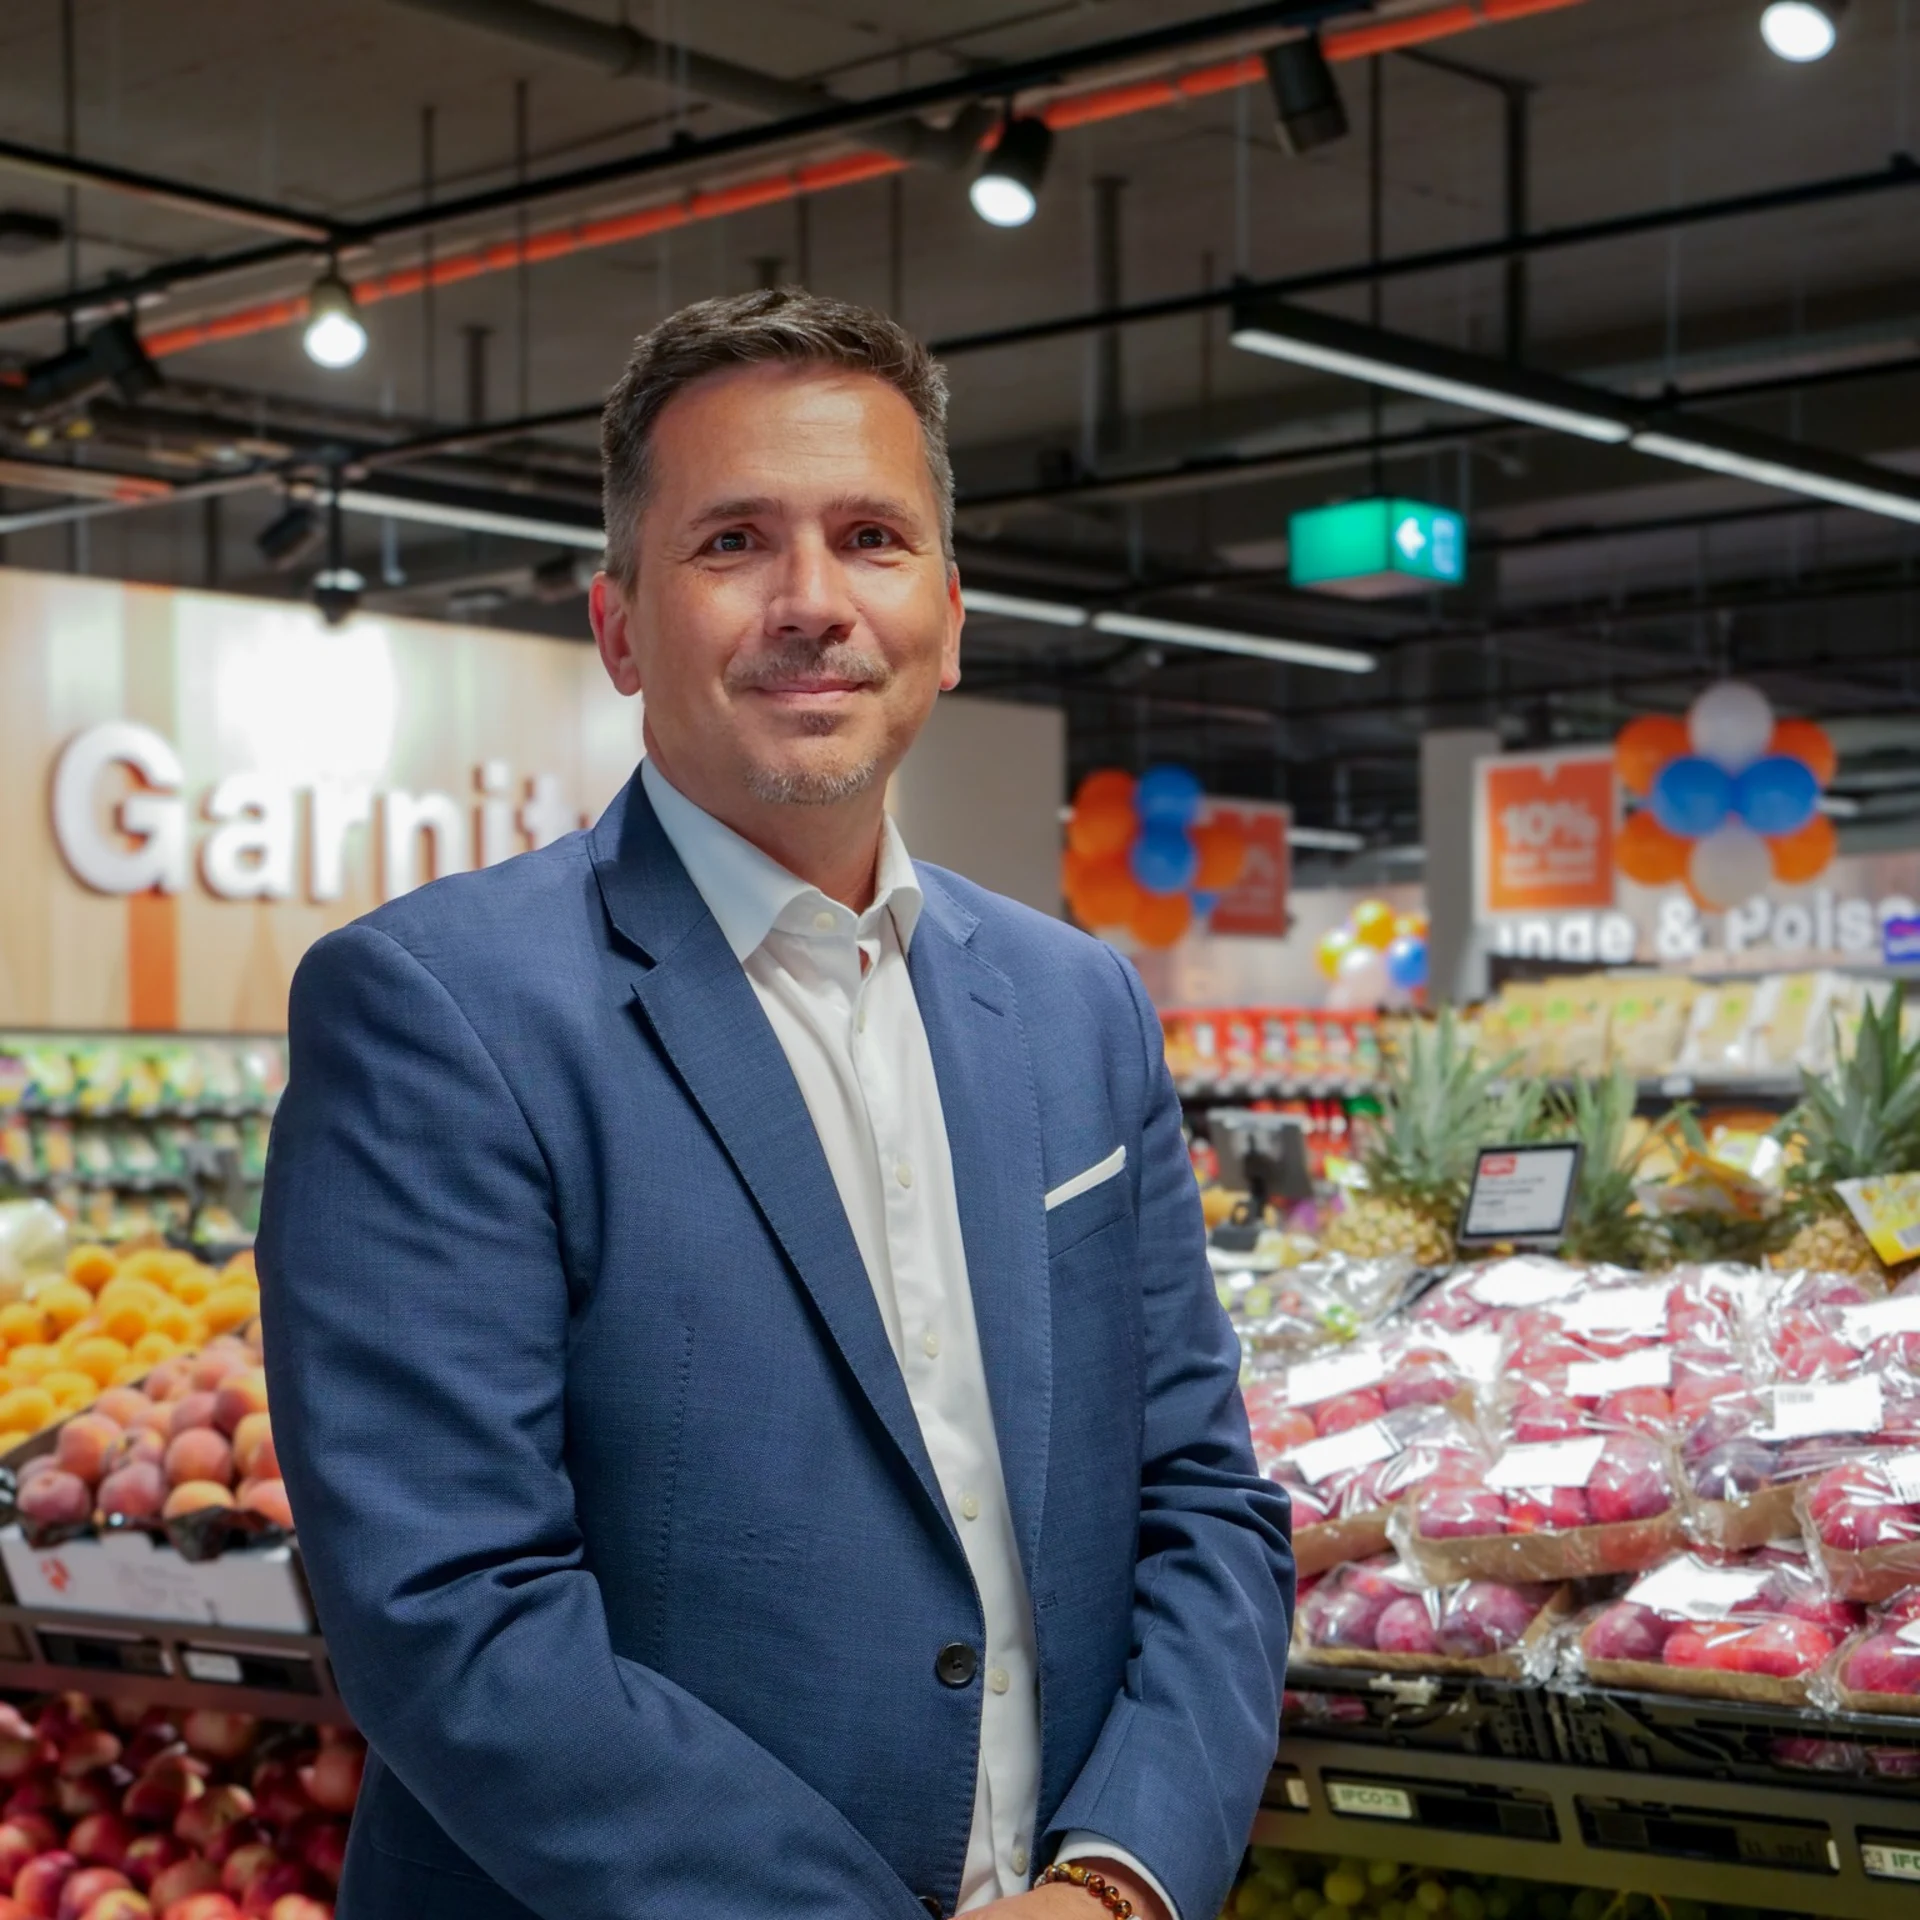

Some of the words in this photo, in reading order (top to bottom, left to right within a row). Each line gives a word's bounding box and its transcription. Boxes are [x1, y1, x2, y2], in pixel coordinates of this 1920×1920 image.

[52, 719, 592, 899] Garnit
[1498, 910, 1635, 963] nde
[1657, 896, 1704, 959] &
